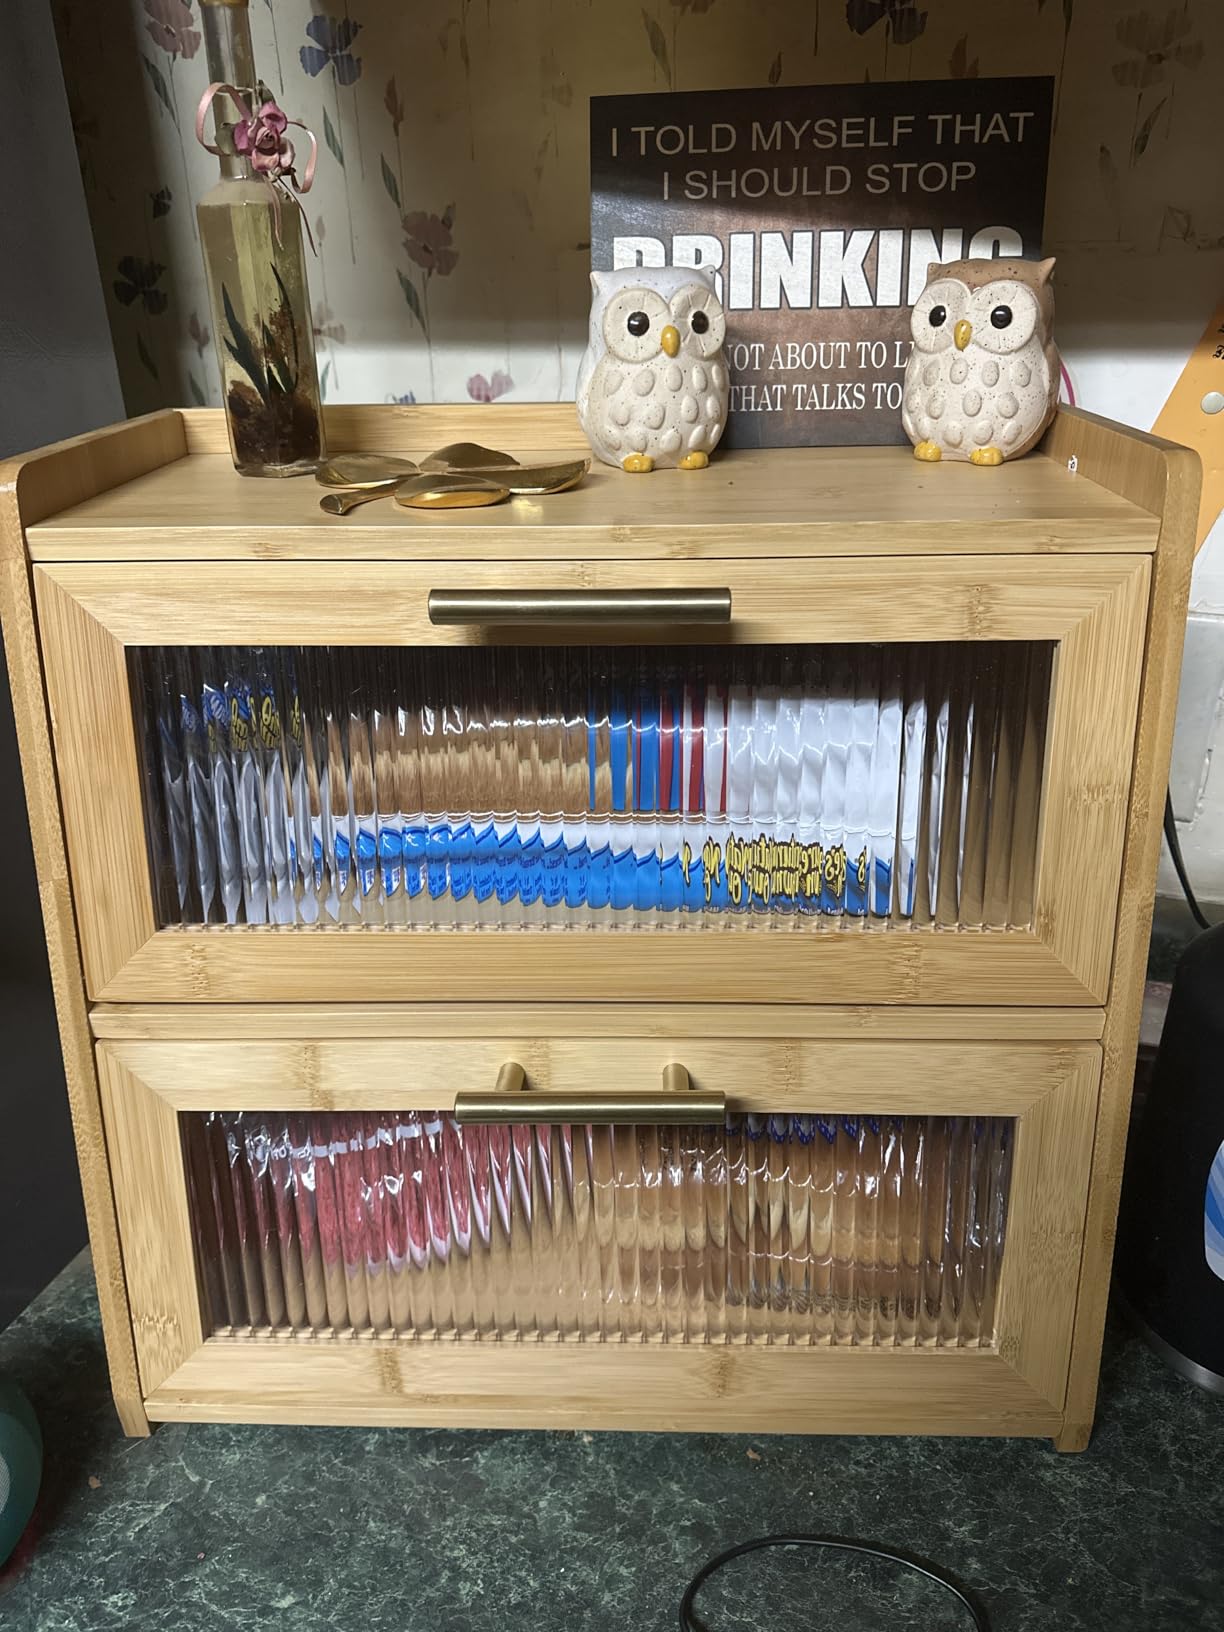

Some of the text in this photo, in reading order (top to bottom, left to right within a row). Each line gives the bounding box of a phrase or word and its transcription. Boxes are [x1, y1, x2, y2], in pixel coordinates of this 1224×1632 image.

[611, 112, 1035, 157] I TOLD MYSELF THAT
[663, 161, 976, 201] I SHOULD STOP
[768, 342, 850, 370] ABOUT
[856, 341, 888, 369] TO
[729, 382, 904, 412] THAT TALKS TO
